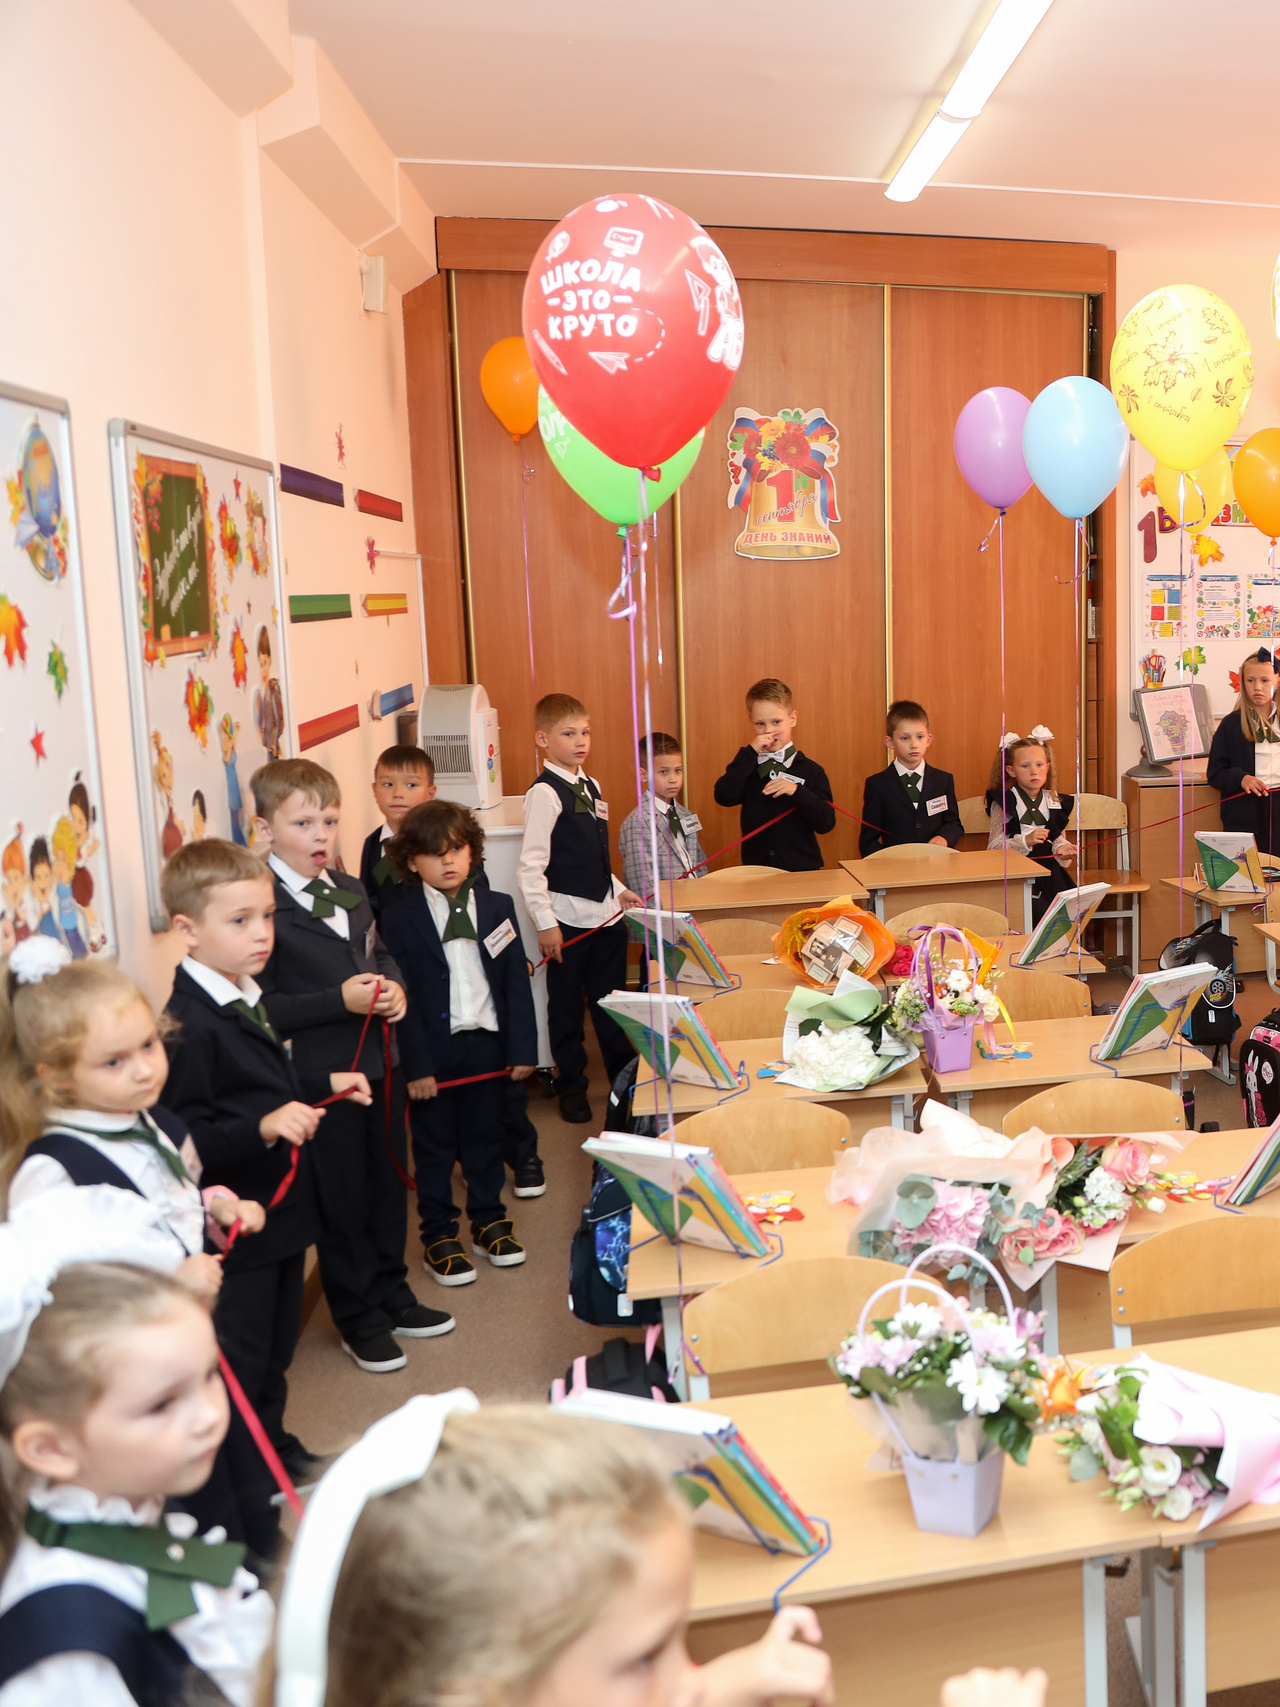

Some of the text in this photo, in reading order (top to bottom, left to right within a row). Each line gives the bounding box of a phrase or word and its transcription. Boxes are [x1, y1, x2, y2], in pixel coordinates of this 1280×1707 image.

[540, 258, 642, 295] ШКОЛА
[547, 312, 638, 341] КРУТО
[766, 469, 795, 522] 1
[741, 530, 833, 546] ДЕНЬ ЗНАНИЙ
